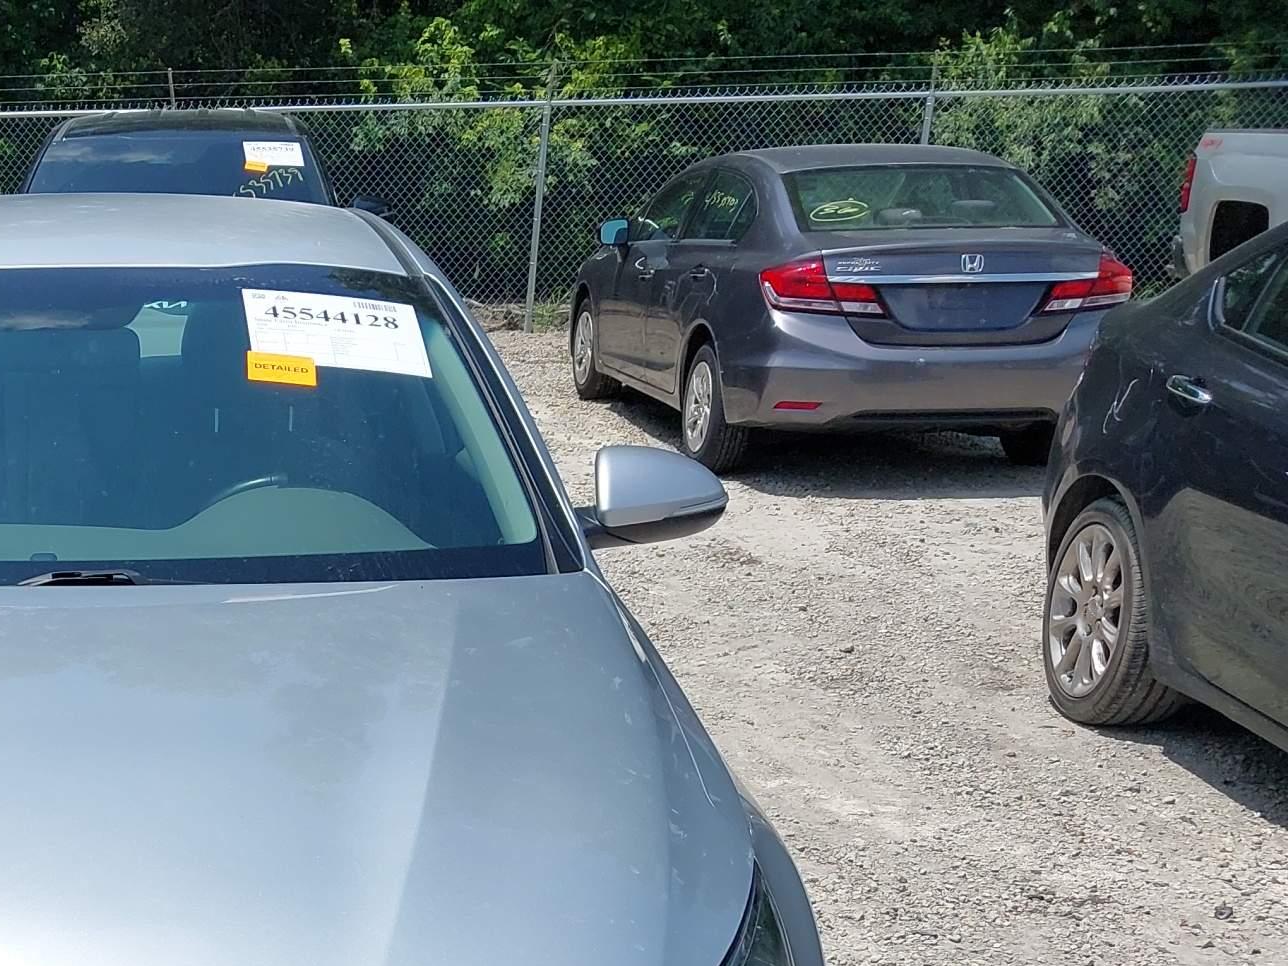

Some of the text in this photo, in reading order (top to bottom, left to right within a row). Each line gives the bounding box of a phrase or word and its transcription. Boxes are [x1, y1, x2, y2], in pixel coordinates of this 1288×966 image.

[232, 167, 304, 198] 535739
[264, 305, 400, 330] 45544128
[254, 362, 309, 374] DETAILED
